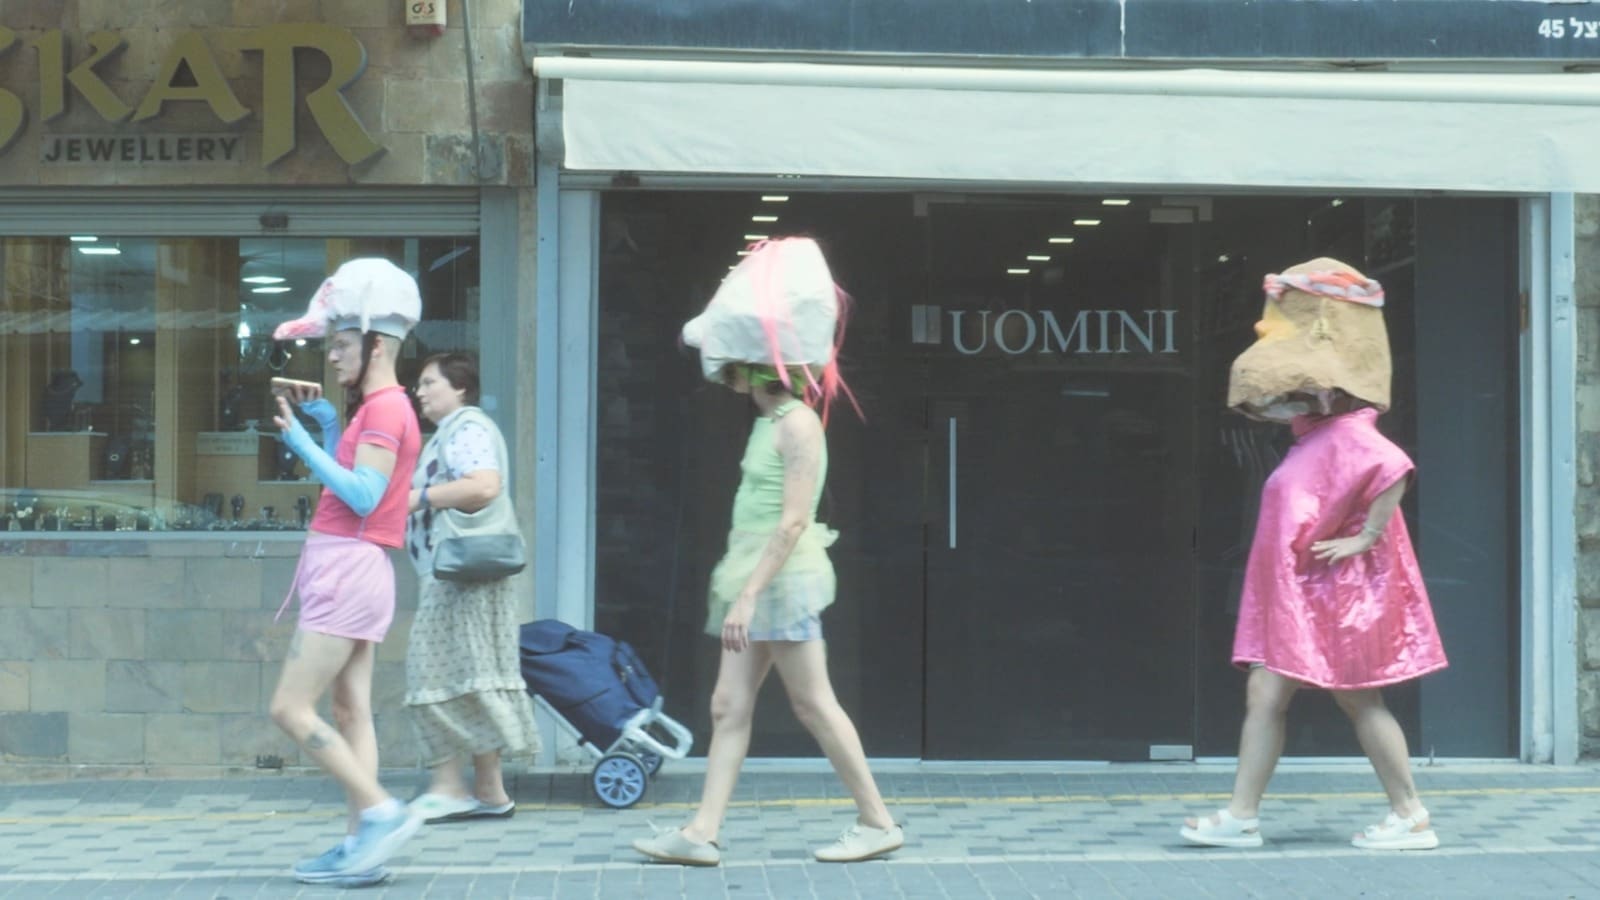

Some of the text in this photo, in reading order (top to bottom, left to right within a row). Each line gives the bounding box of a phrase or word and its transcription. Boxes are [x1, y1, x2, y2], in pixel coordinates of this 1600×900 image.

[1538, 17, 1600, 38] צל 45
[45, 137, 238, 162] JEWELLERY
[948, 309, 1179, 355] UOMINI
